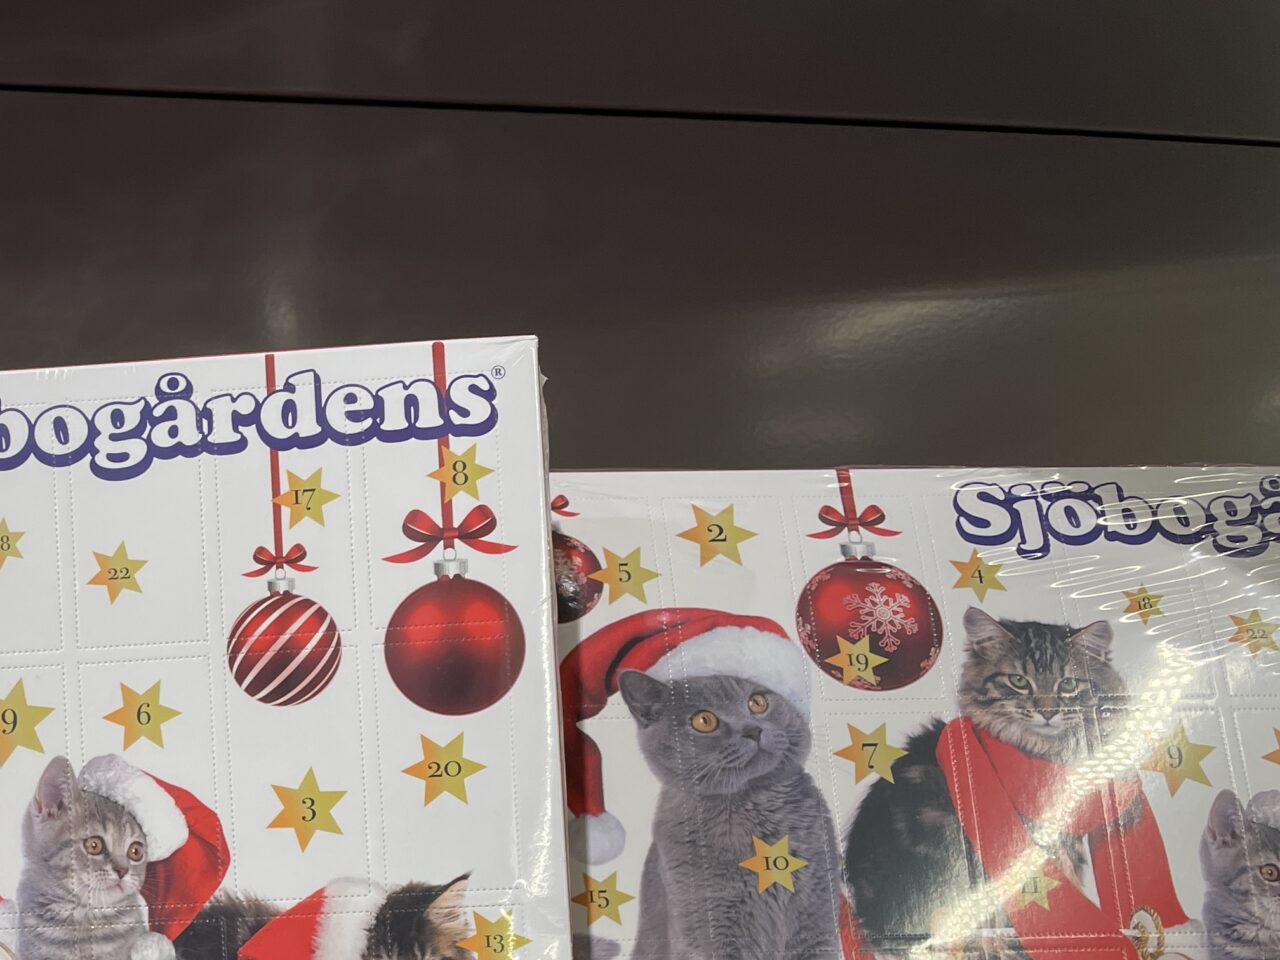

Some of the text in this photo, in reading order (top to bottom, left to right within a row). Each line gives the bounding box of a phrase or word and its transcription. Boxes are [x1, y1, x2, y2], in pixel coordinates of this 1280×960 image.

[451, 460, 469, 486] 8
[291, 488, 316, 511] 17
[707, 523, 728, 543] 2
[107, 567, 131, 582] 22
[618, 562, 632, 583] 5
[971, 567, 985, 585] 4
[846, 652, 869, 671] 19
[0, 709, 19, 735] 9
[136, 702, 152, 726] 6
[861, 742, 879, 770] 7
[427, 760, 462, 779] 20
[301, 797, 317, 822] 3
[762, 854, 790, 872] 10
[586, 889, 610, 910] 15
[484, 934, 505, 955] 13
